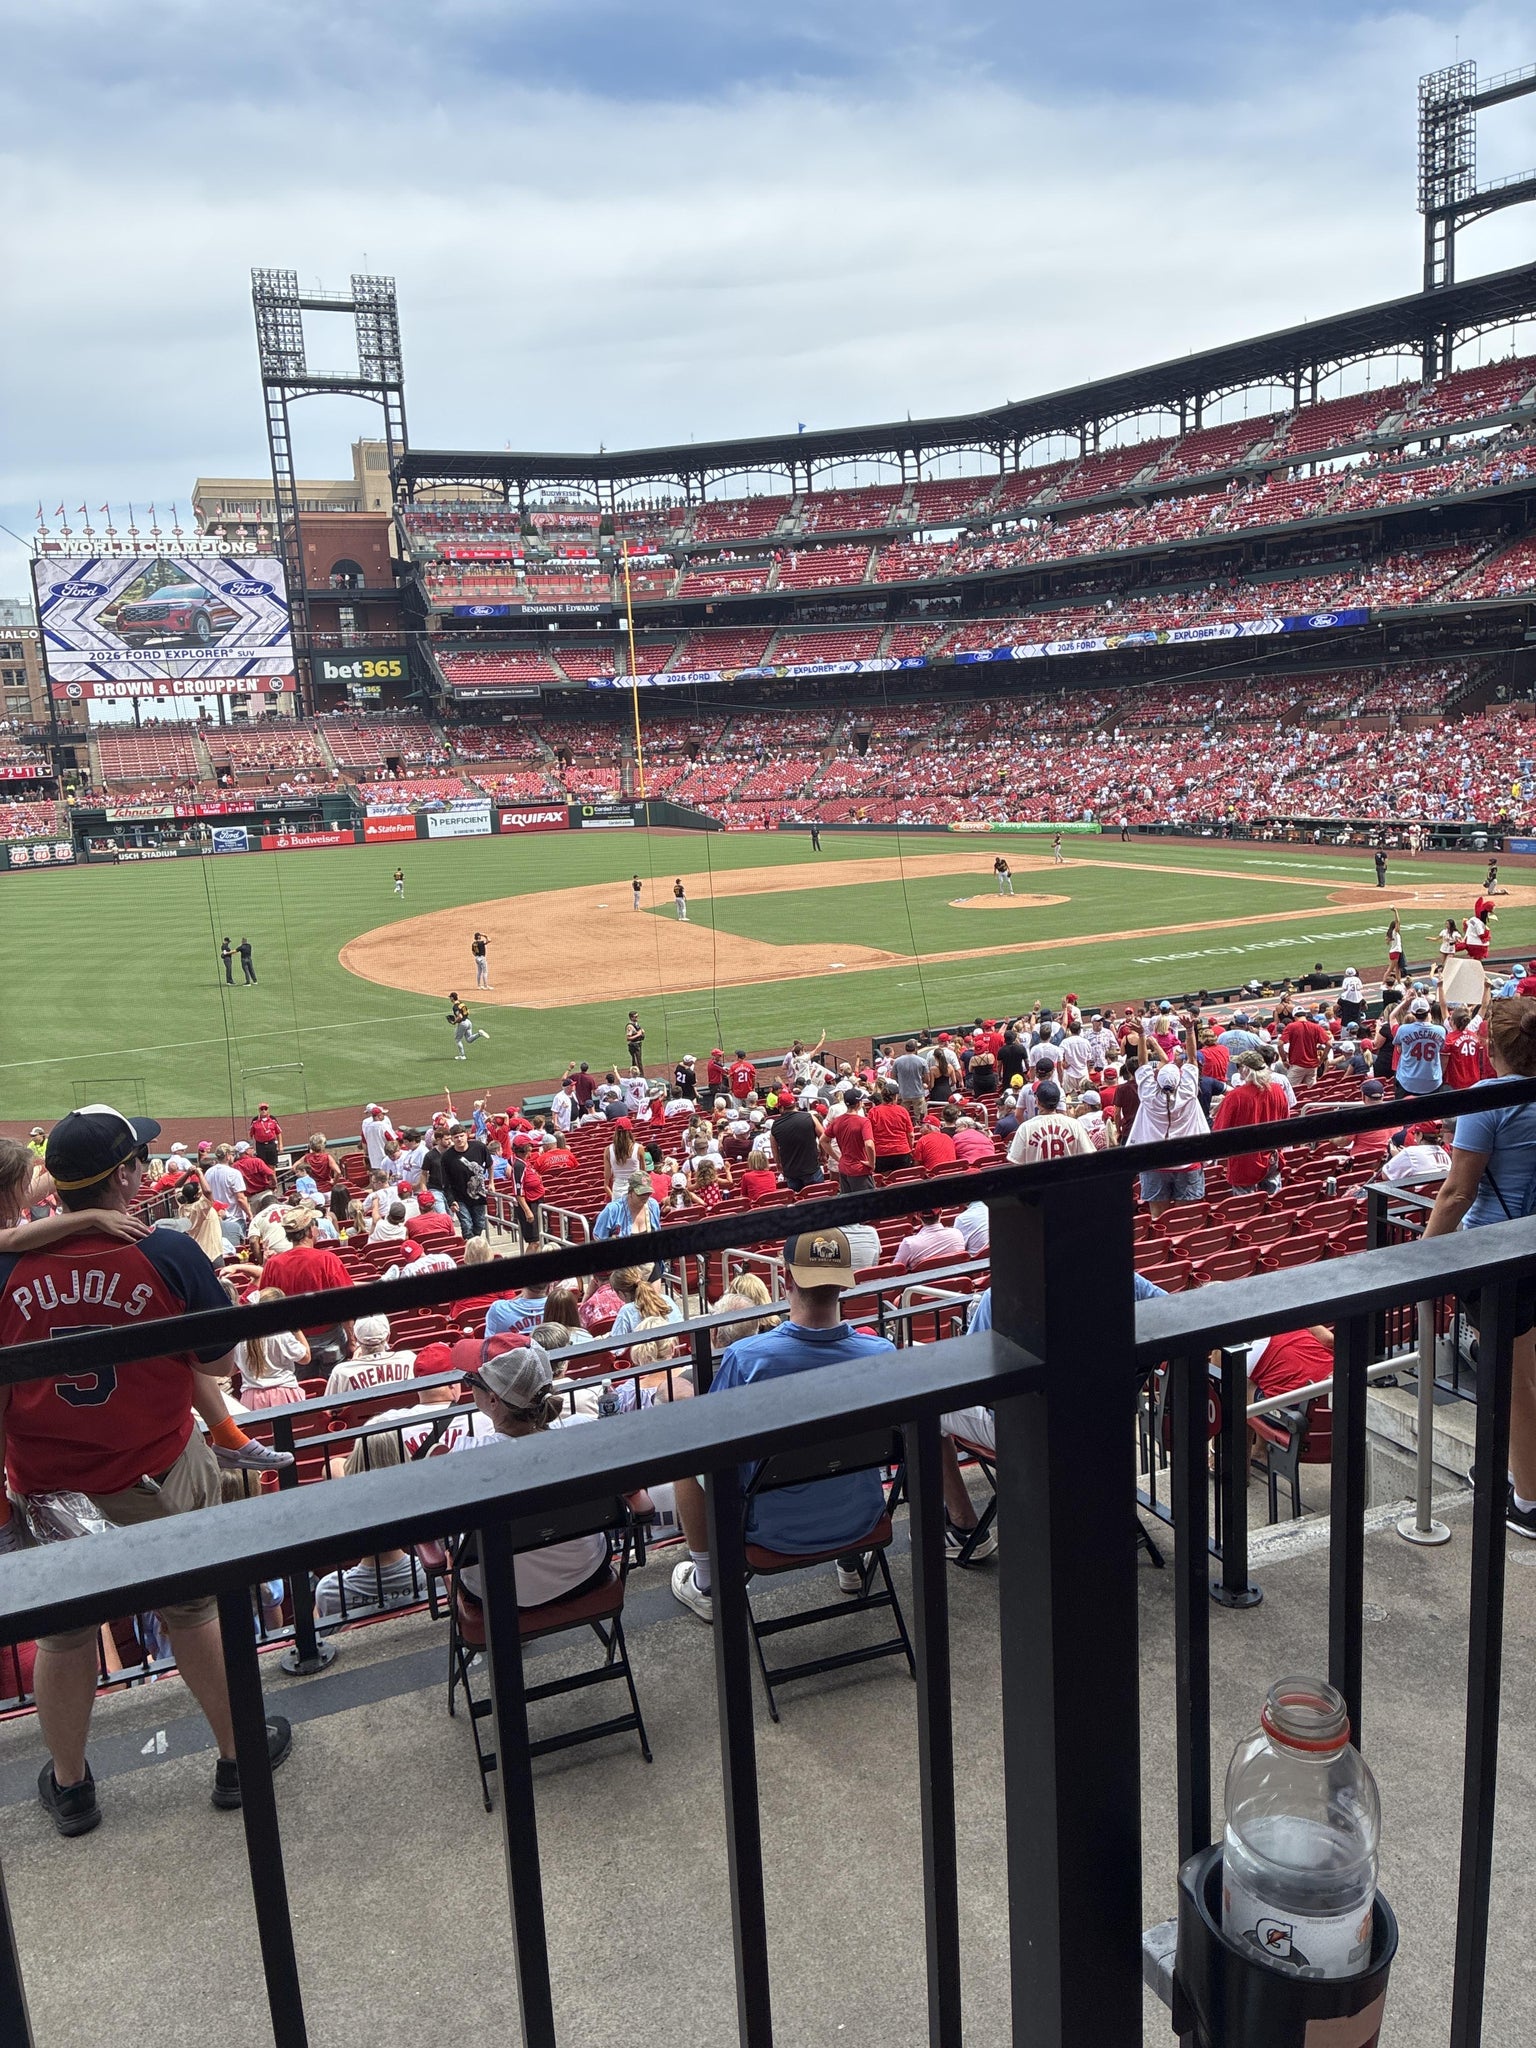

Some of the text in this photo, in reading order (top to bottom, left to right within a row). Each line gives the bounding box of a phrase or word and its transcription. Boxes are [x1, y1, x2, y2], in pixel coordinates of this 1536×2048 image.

[59, 541, 258, 555] WORLD CHAMPIONS
[61, 583, 98, 597] Ford
[229, 582, 264, 595] Ford
[521, 605, 557, 614] BENJAMIN
[1313, 615, 1333, 626] Ford
[1057, 641, 1096, 652] 2026 FORD
[89, 651, 121, 661] 2026
[125, 650, 162, 660] FORD
[323, 660, 402, 679] bet365
[667, 673, 710, 683] 2026 FORD
[93, 678, 257, 696] BROWN & CROUPPEN
[8, 769, 14, 778] 2
[37, 768, 44, 776] 5
[263, 802, 278, 810] Mercy
[112, 807, 166, 817] Schnucks
[439, 816, 488, 826] PERFICIENT
[502, 811, 564, 827] EQUIFAX
[219, 830, 241, 840] Ford
[291, 835, 340, 845] Budweiser
[14, 853, 26, 861] 66
[36, 851, 47, 859] 66
[57, 849, 69, 857] 66
[141, 850, 177, 859] STADIUM
[1411, 1042, 1436, 1062] 46
[1461, 1042, 1476, 1056] 46
[676, 1072, 686, 1083] 21
[738, 1072, 748, 1083] 21
[633, 1087, 640, 1097] 4
[1029, 1124, 1076, 1147] SHANNON
[1041, 1139, 1065, 1160] 18
[12, 1269, 153, 1321] PUJOLS
[50, 1324, 118, 1407] 5
[349, 1363, 410, 1390] ARENADO
